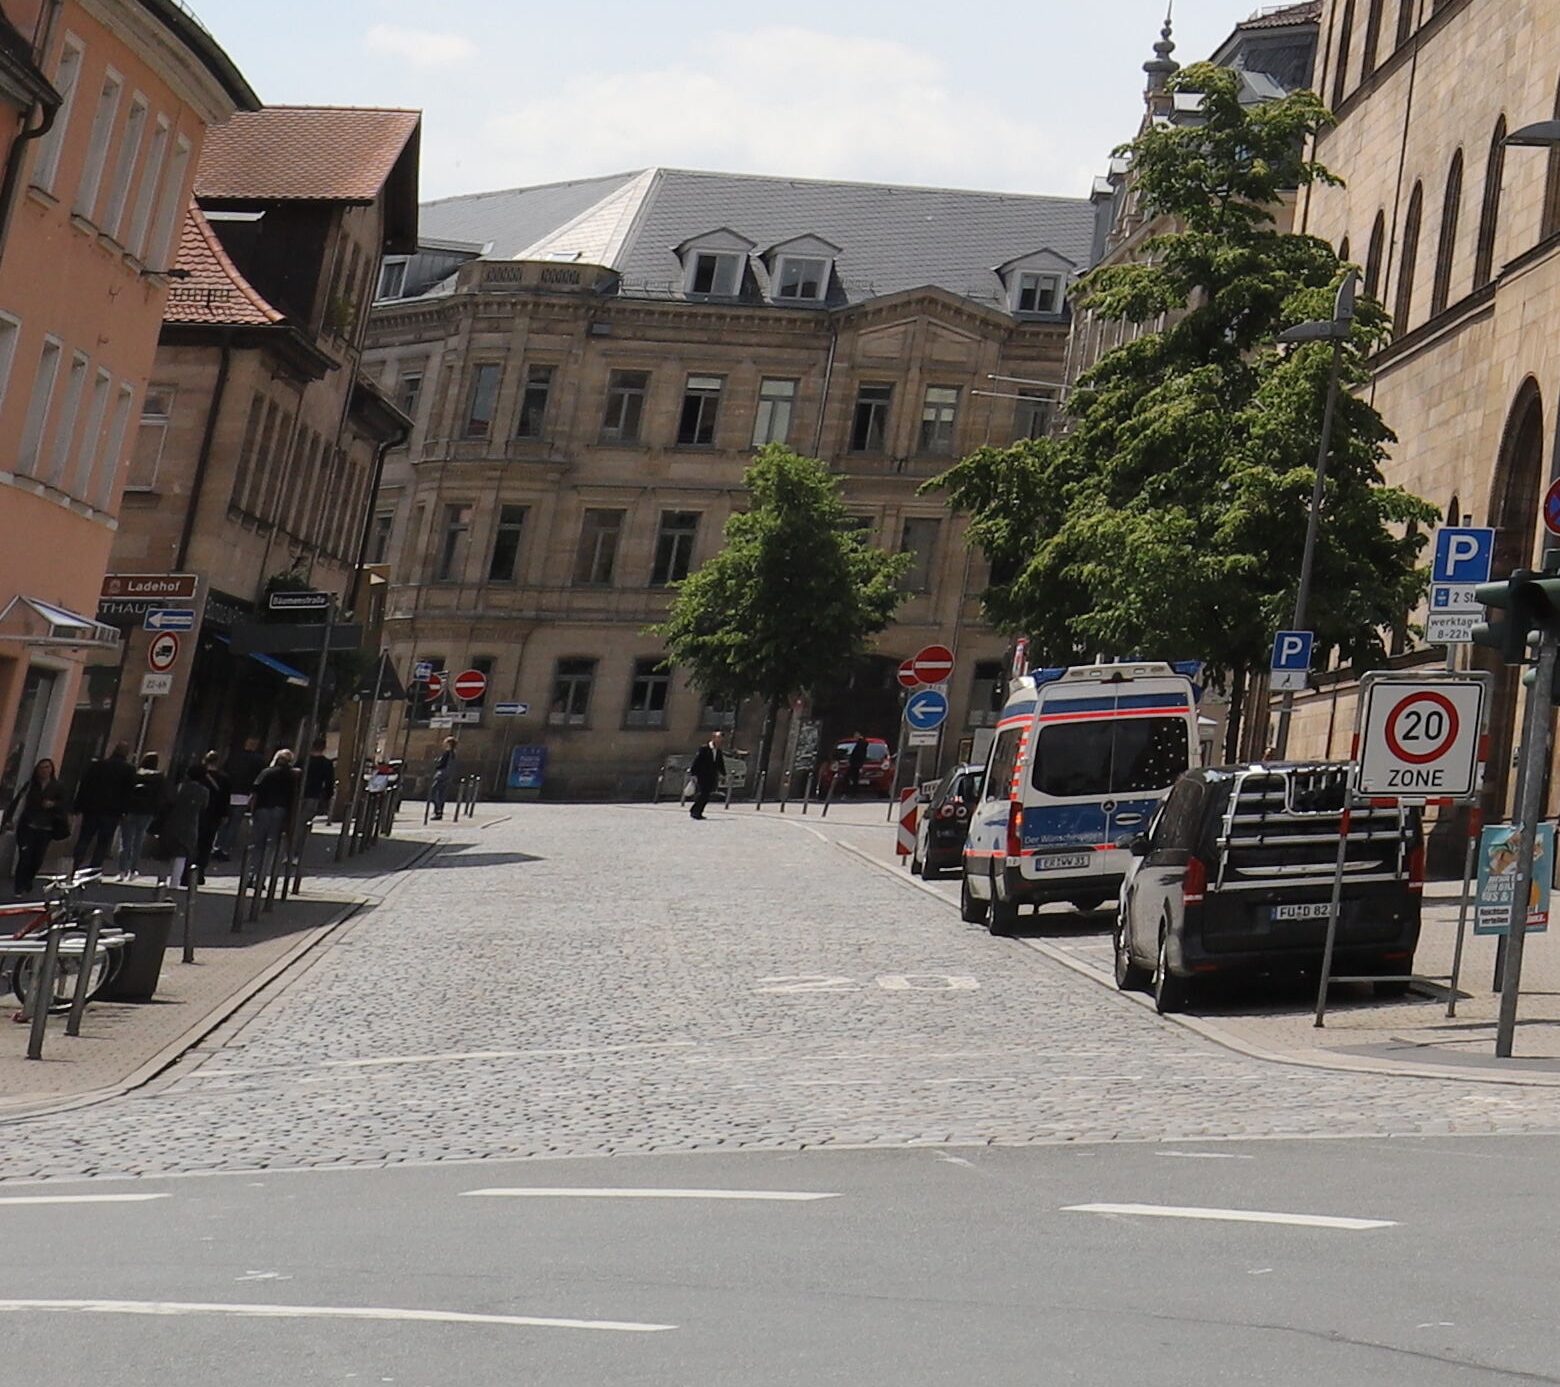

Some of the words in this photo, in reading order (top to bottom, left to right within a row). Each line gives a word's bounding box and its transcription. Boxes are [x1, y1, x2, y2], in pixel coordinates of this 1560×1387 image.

[127, 580, 181, 592] Ladehof
[1453, 591, 1460, 604] 2
[1437, 629, 1470, 640] 8-22h
[1401, 710, 1444, 742] 20
[1387, 769, 1445, 788] ZONE
